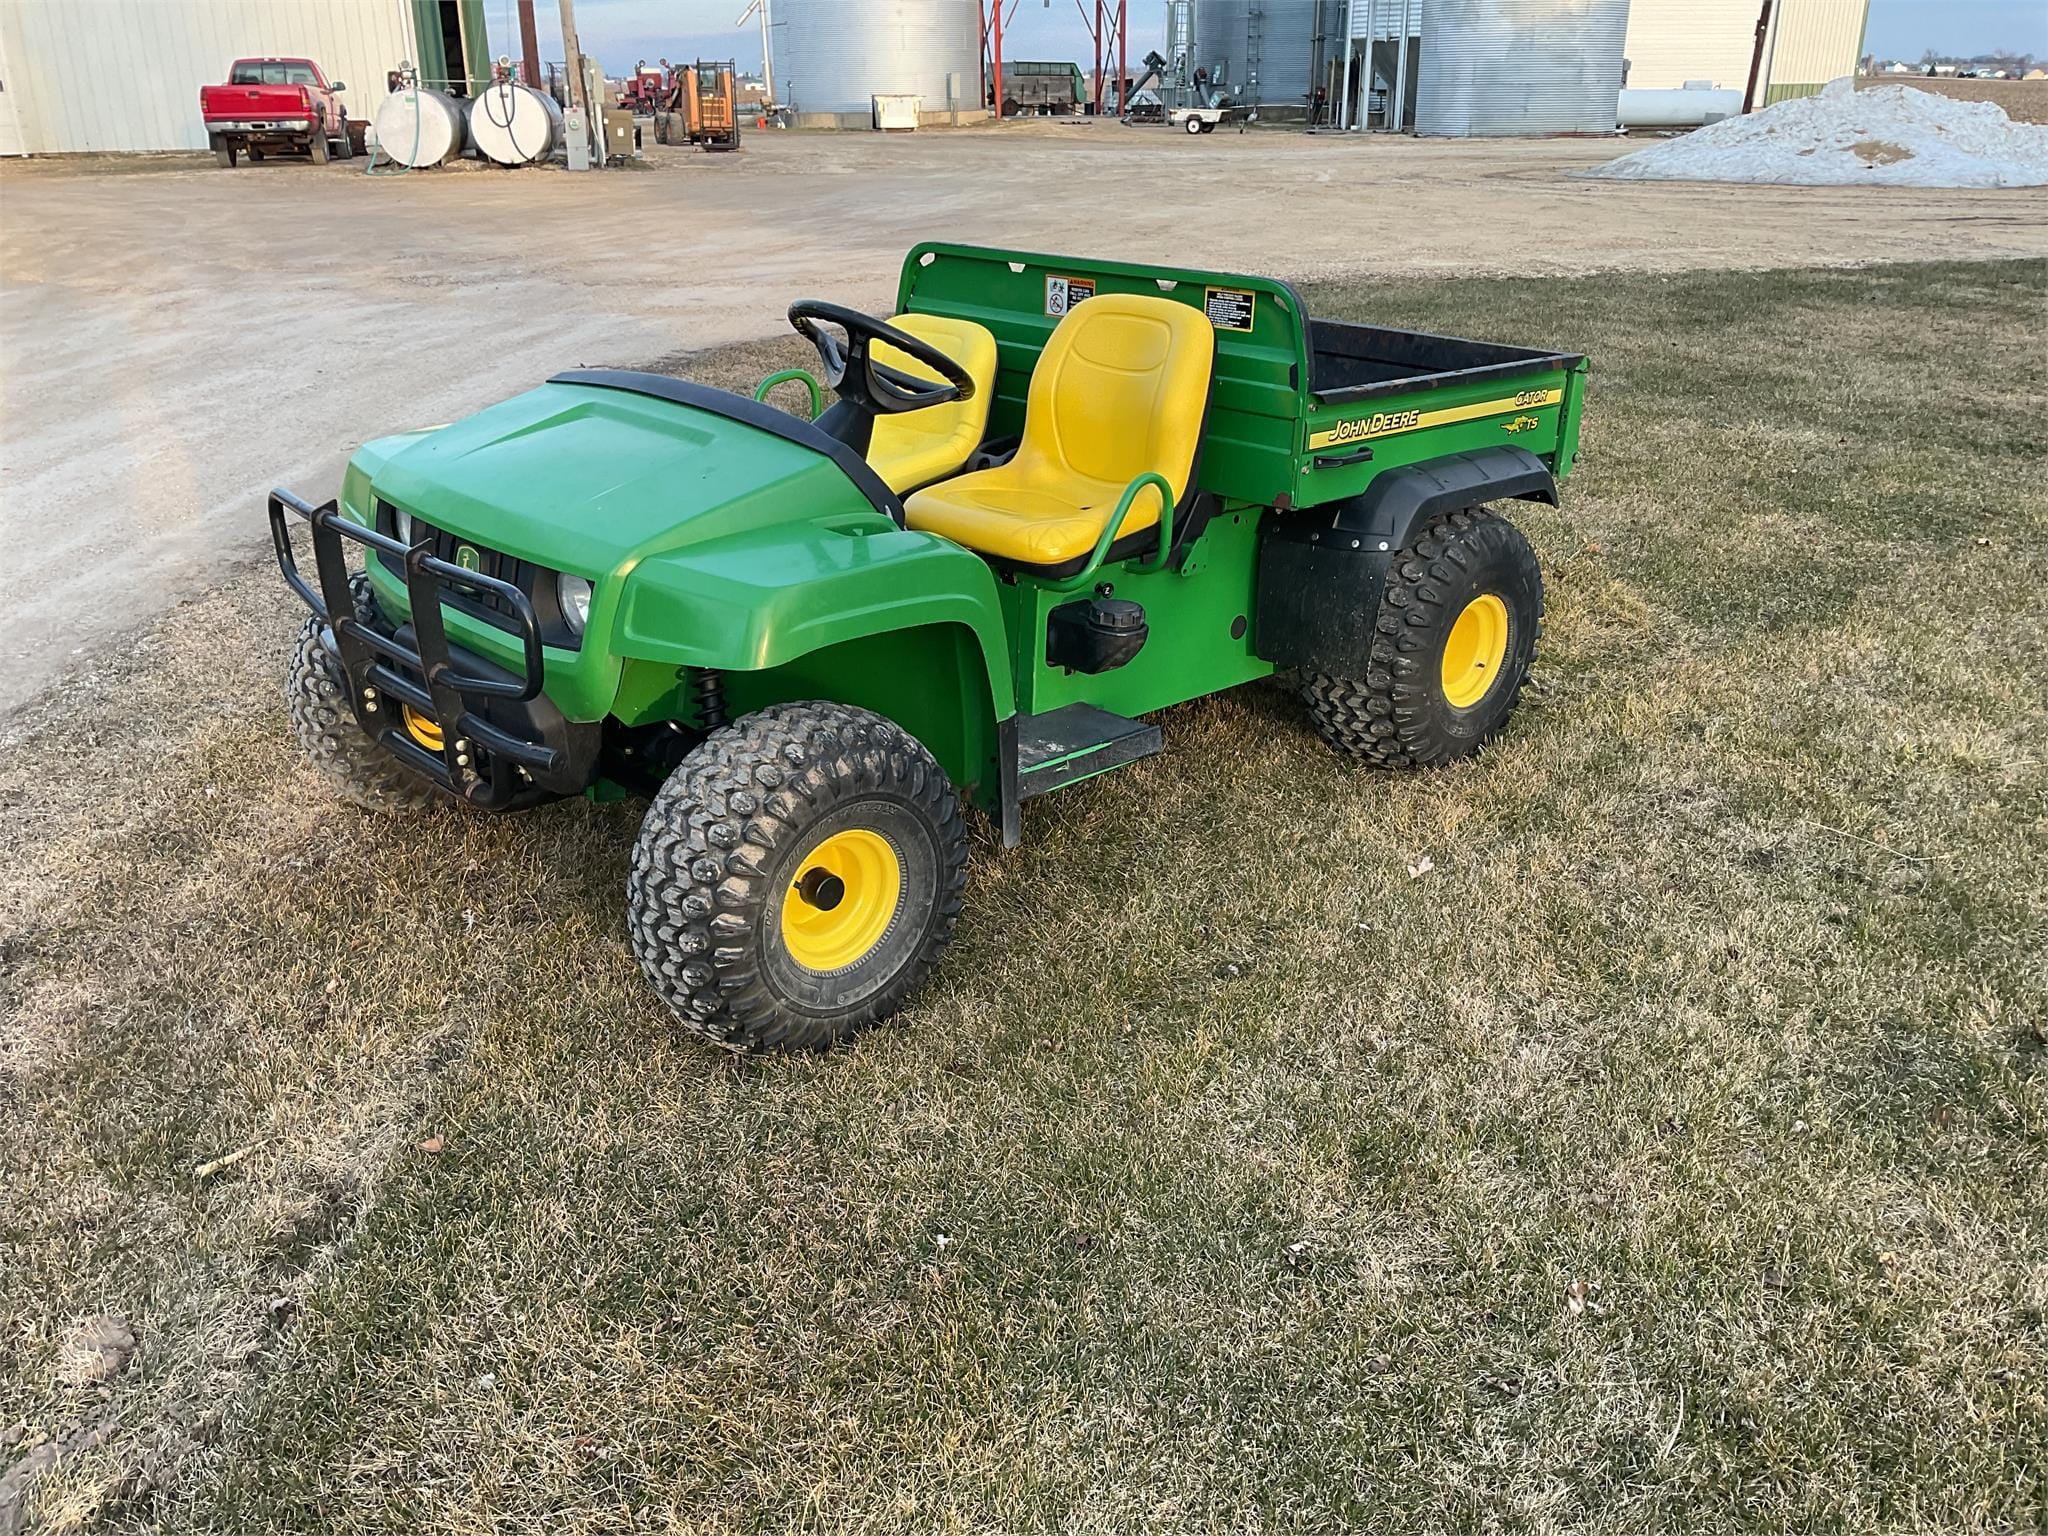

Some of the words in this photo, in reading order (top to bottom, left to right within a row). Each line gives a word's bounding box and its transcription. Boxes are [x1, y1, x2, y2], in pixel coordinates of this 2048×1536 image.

[1515, 390, 1547, 406] GATOR
[1328, 420, 1370, 441] JOHN
[1370, 410, 1419, 433] DEERE
[1526, 417, 1539, 431] TS
